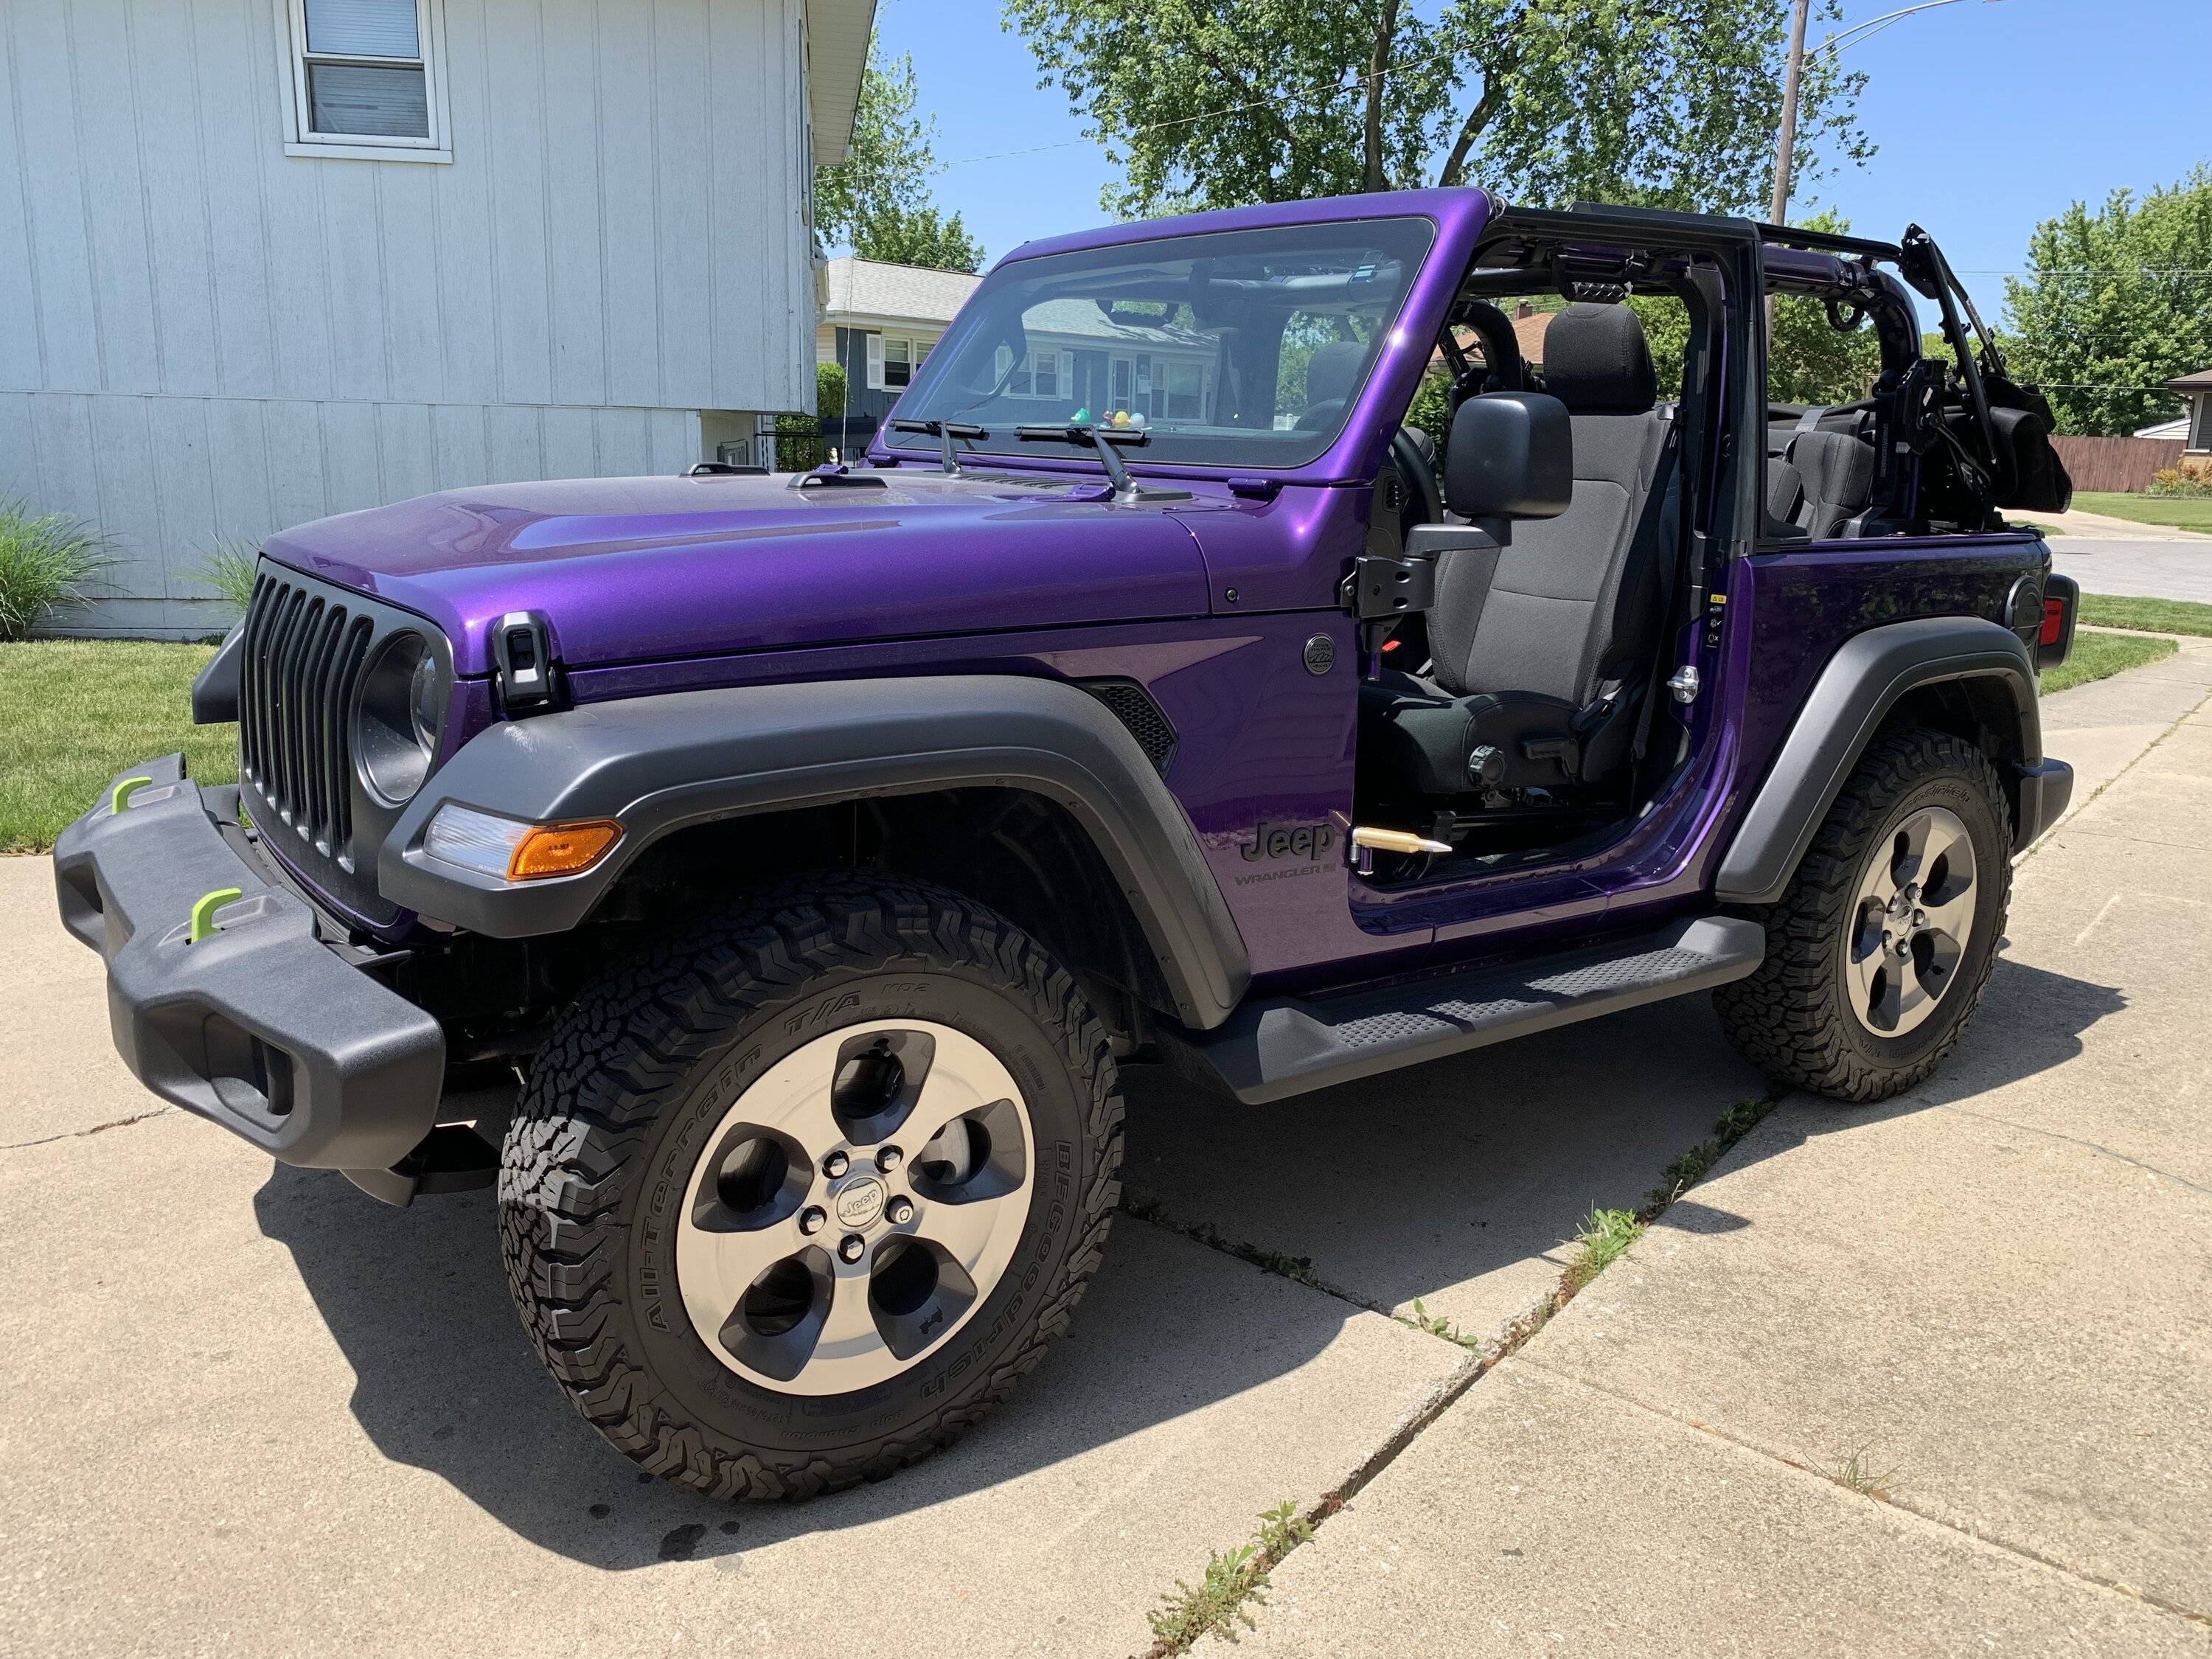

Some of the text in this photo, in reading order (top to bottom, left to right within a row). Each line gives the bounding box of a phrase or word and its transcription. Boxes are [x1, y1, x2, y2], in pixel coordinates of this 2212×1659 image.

[1240, 821, 1336, 861] Jeep
[1234, 866, 1321, 886] WRANGLER
[640, 1043, 762, 1333] All-Terrain
[784, 990, 862, 1037] T/A
[844, 1189, 877, 1214] Jeep
[920, 1140, 1074, 1401] BFGoodrich
